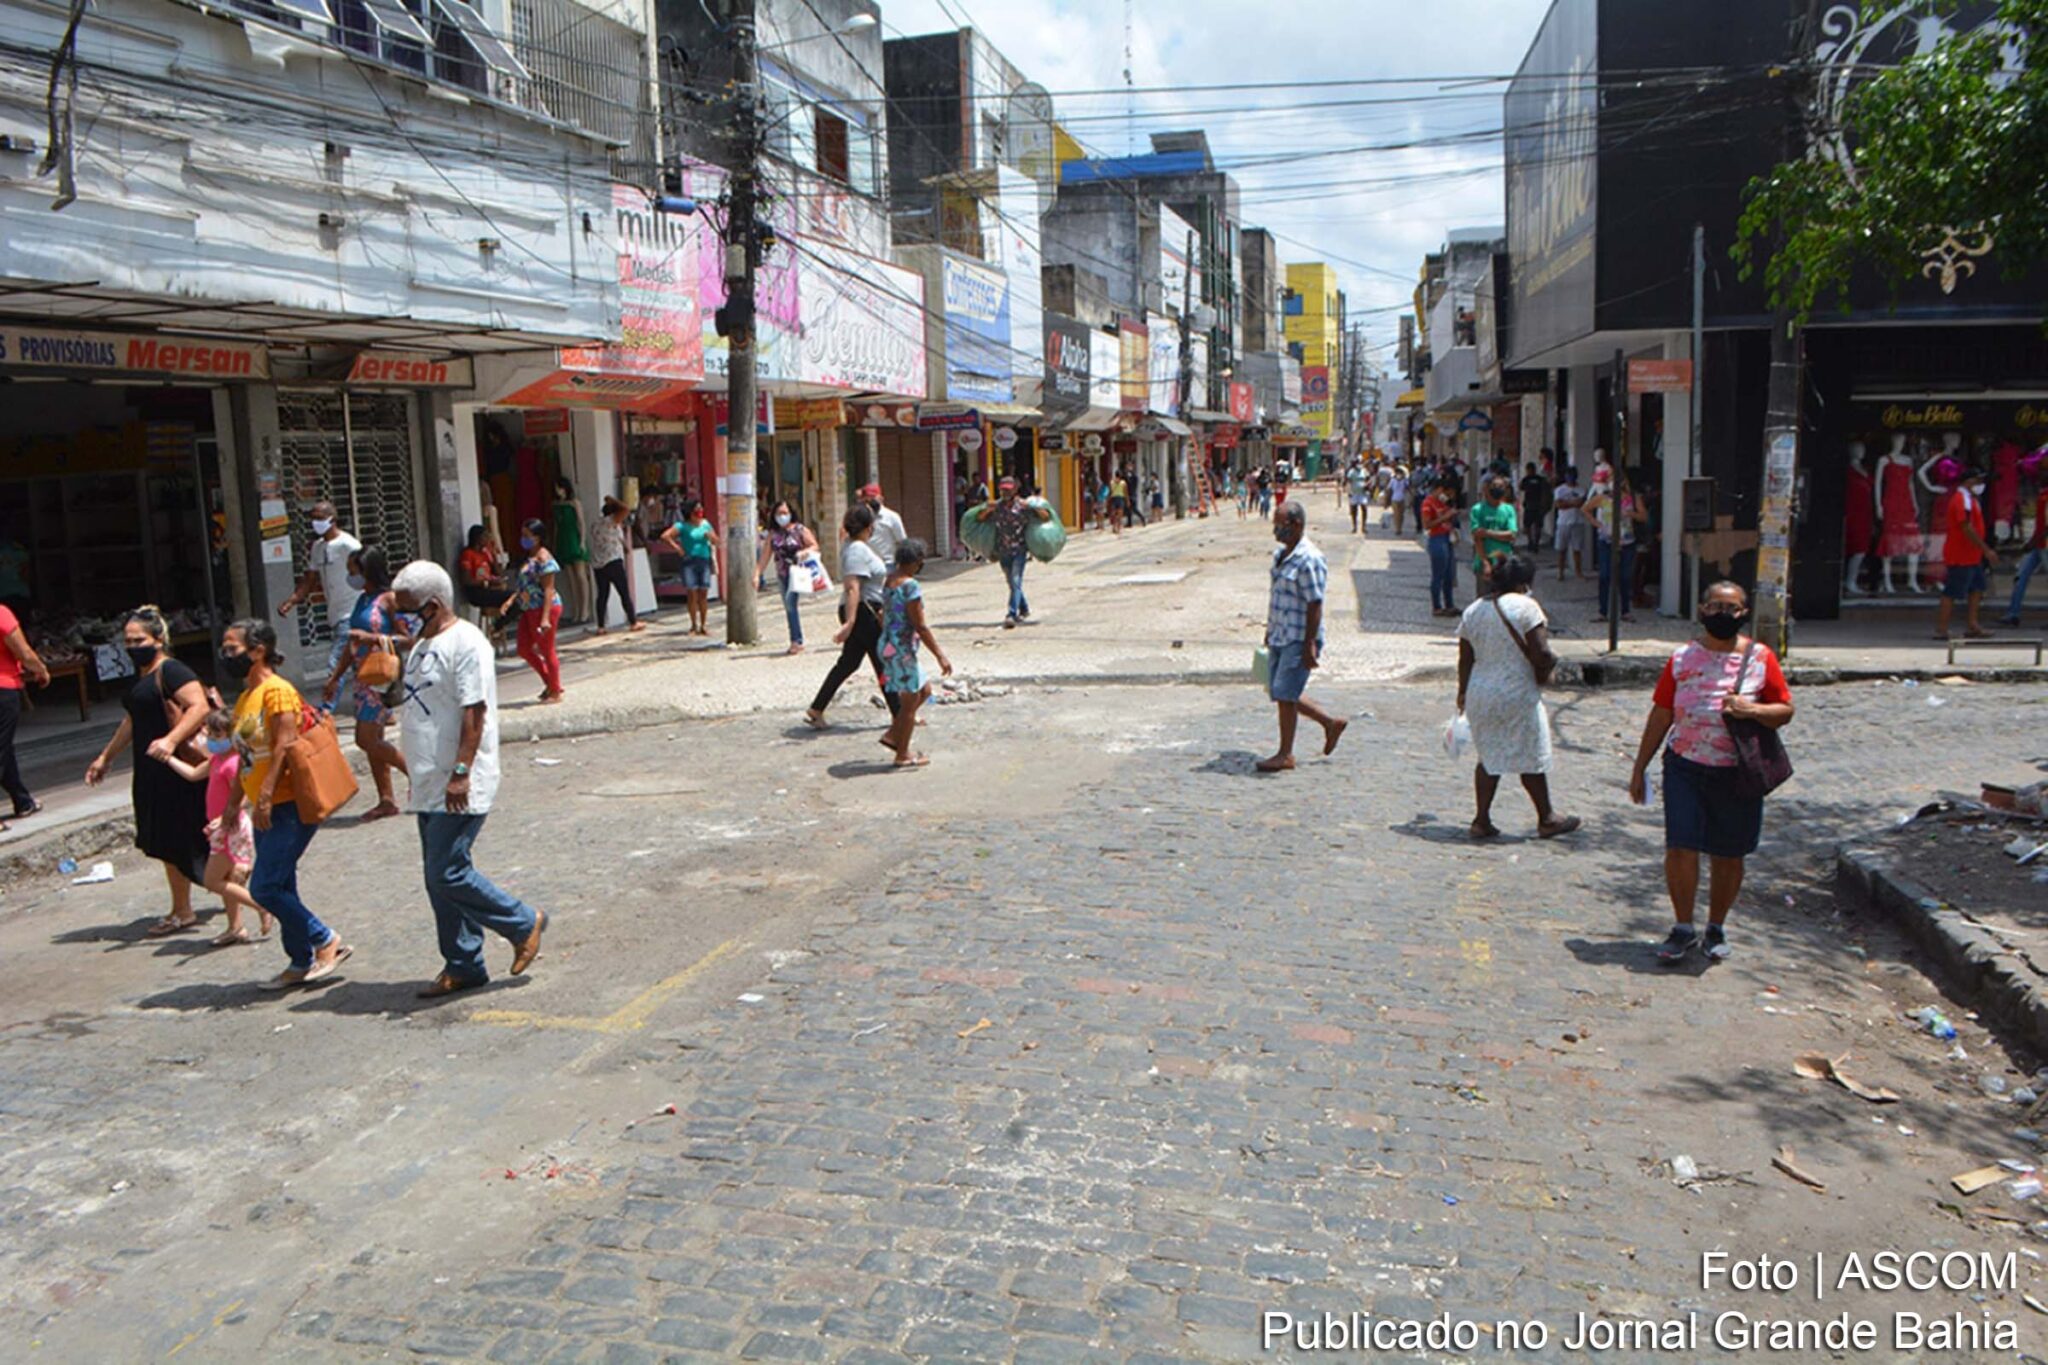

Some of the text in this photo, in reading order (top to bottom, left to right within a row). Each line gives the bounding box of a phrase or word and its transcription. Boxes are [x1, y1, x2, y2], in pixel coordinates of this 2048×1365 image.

[127, 338, 251, 375] Mersan
[350, 354, 448, 384] ersan
[1923, 404, 1964, 425] Belle
